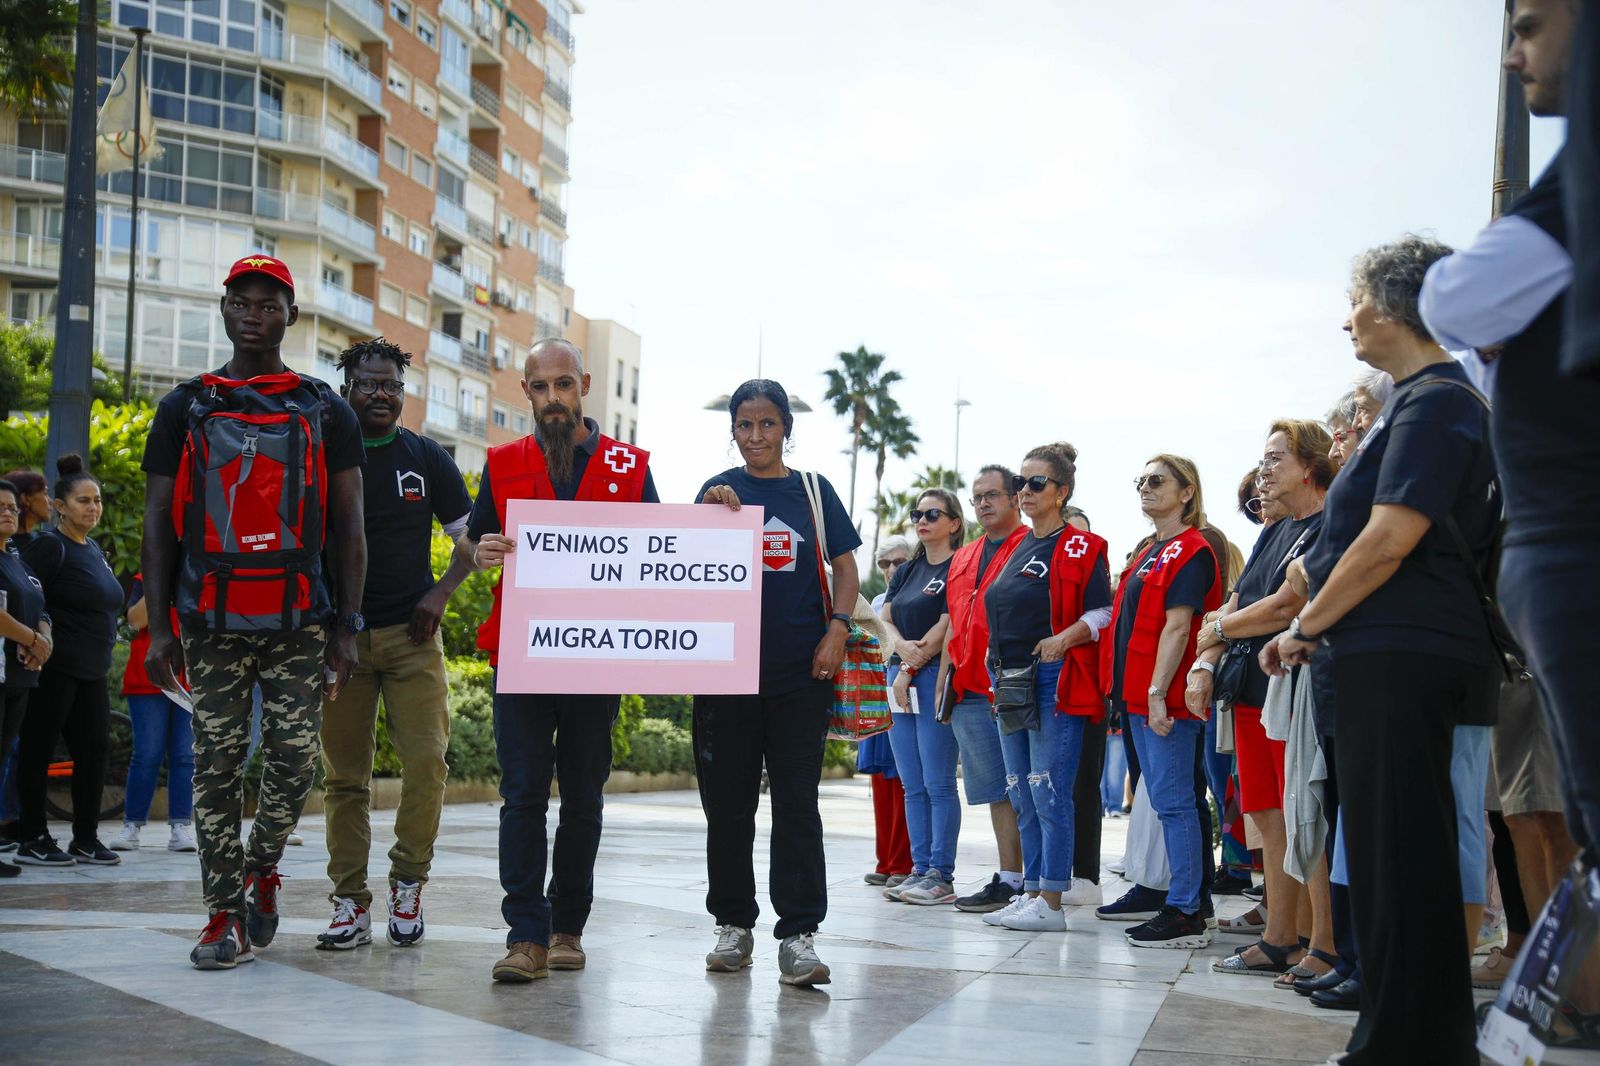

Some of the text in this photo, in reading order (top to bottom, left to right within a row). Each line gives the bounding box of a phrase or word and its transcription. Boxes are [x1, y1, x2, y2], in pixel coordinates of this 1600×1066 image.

[526, 531, 678, 555] VENIMOS DE
[589, 563, 748, 583] UN PROCESO
[531, 626, 698, 651] MIGRATORIO
